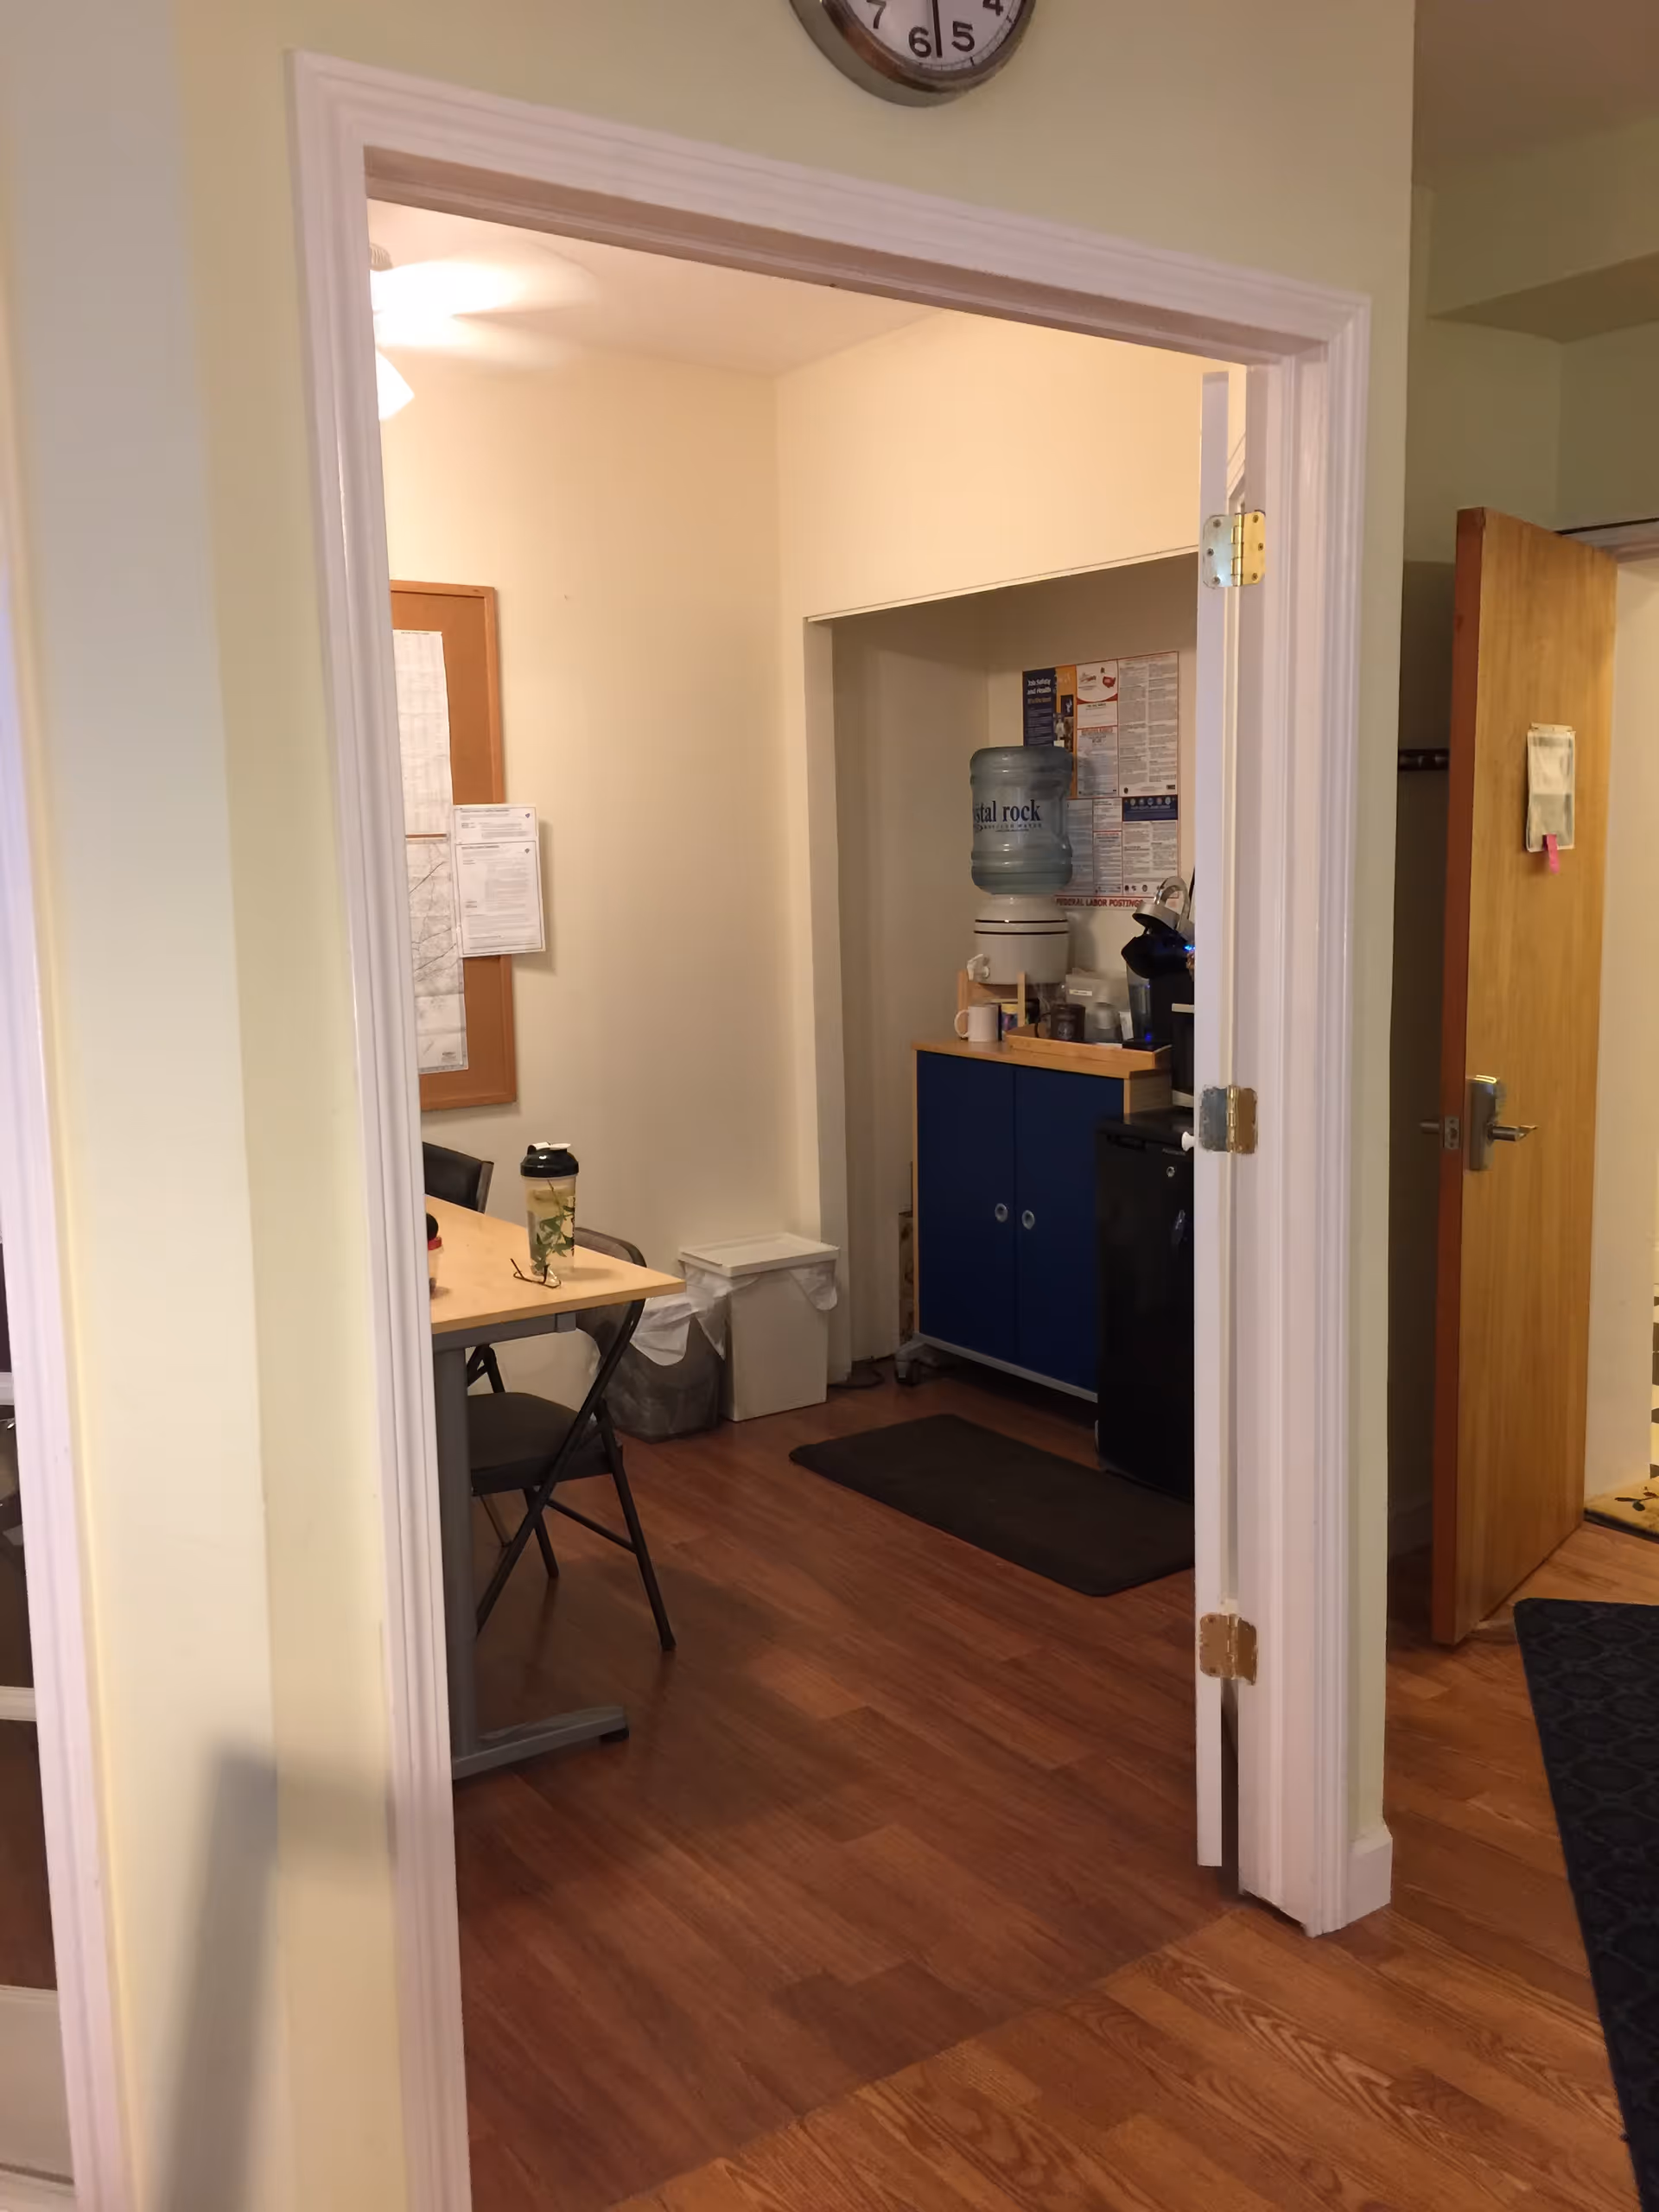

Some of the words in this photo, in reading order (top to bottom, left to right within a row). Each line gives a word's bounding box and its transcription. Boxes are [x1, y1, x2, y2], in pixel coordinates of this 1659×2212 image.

[867, 0, 887, 29] 7
[908, 26, 932, 58] 6
[951, 20, 976, 52] 5
[1002, 799, 1041, 822] rock
[1056, 898, 1084, 906] FEDERAL
[1085, 899, 1107, 907] LABOR
